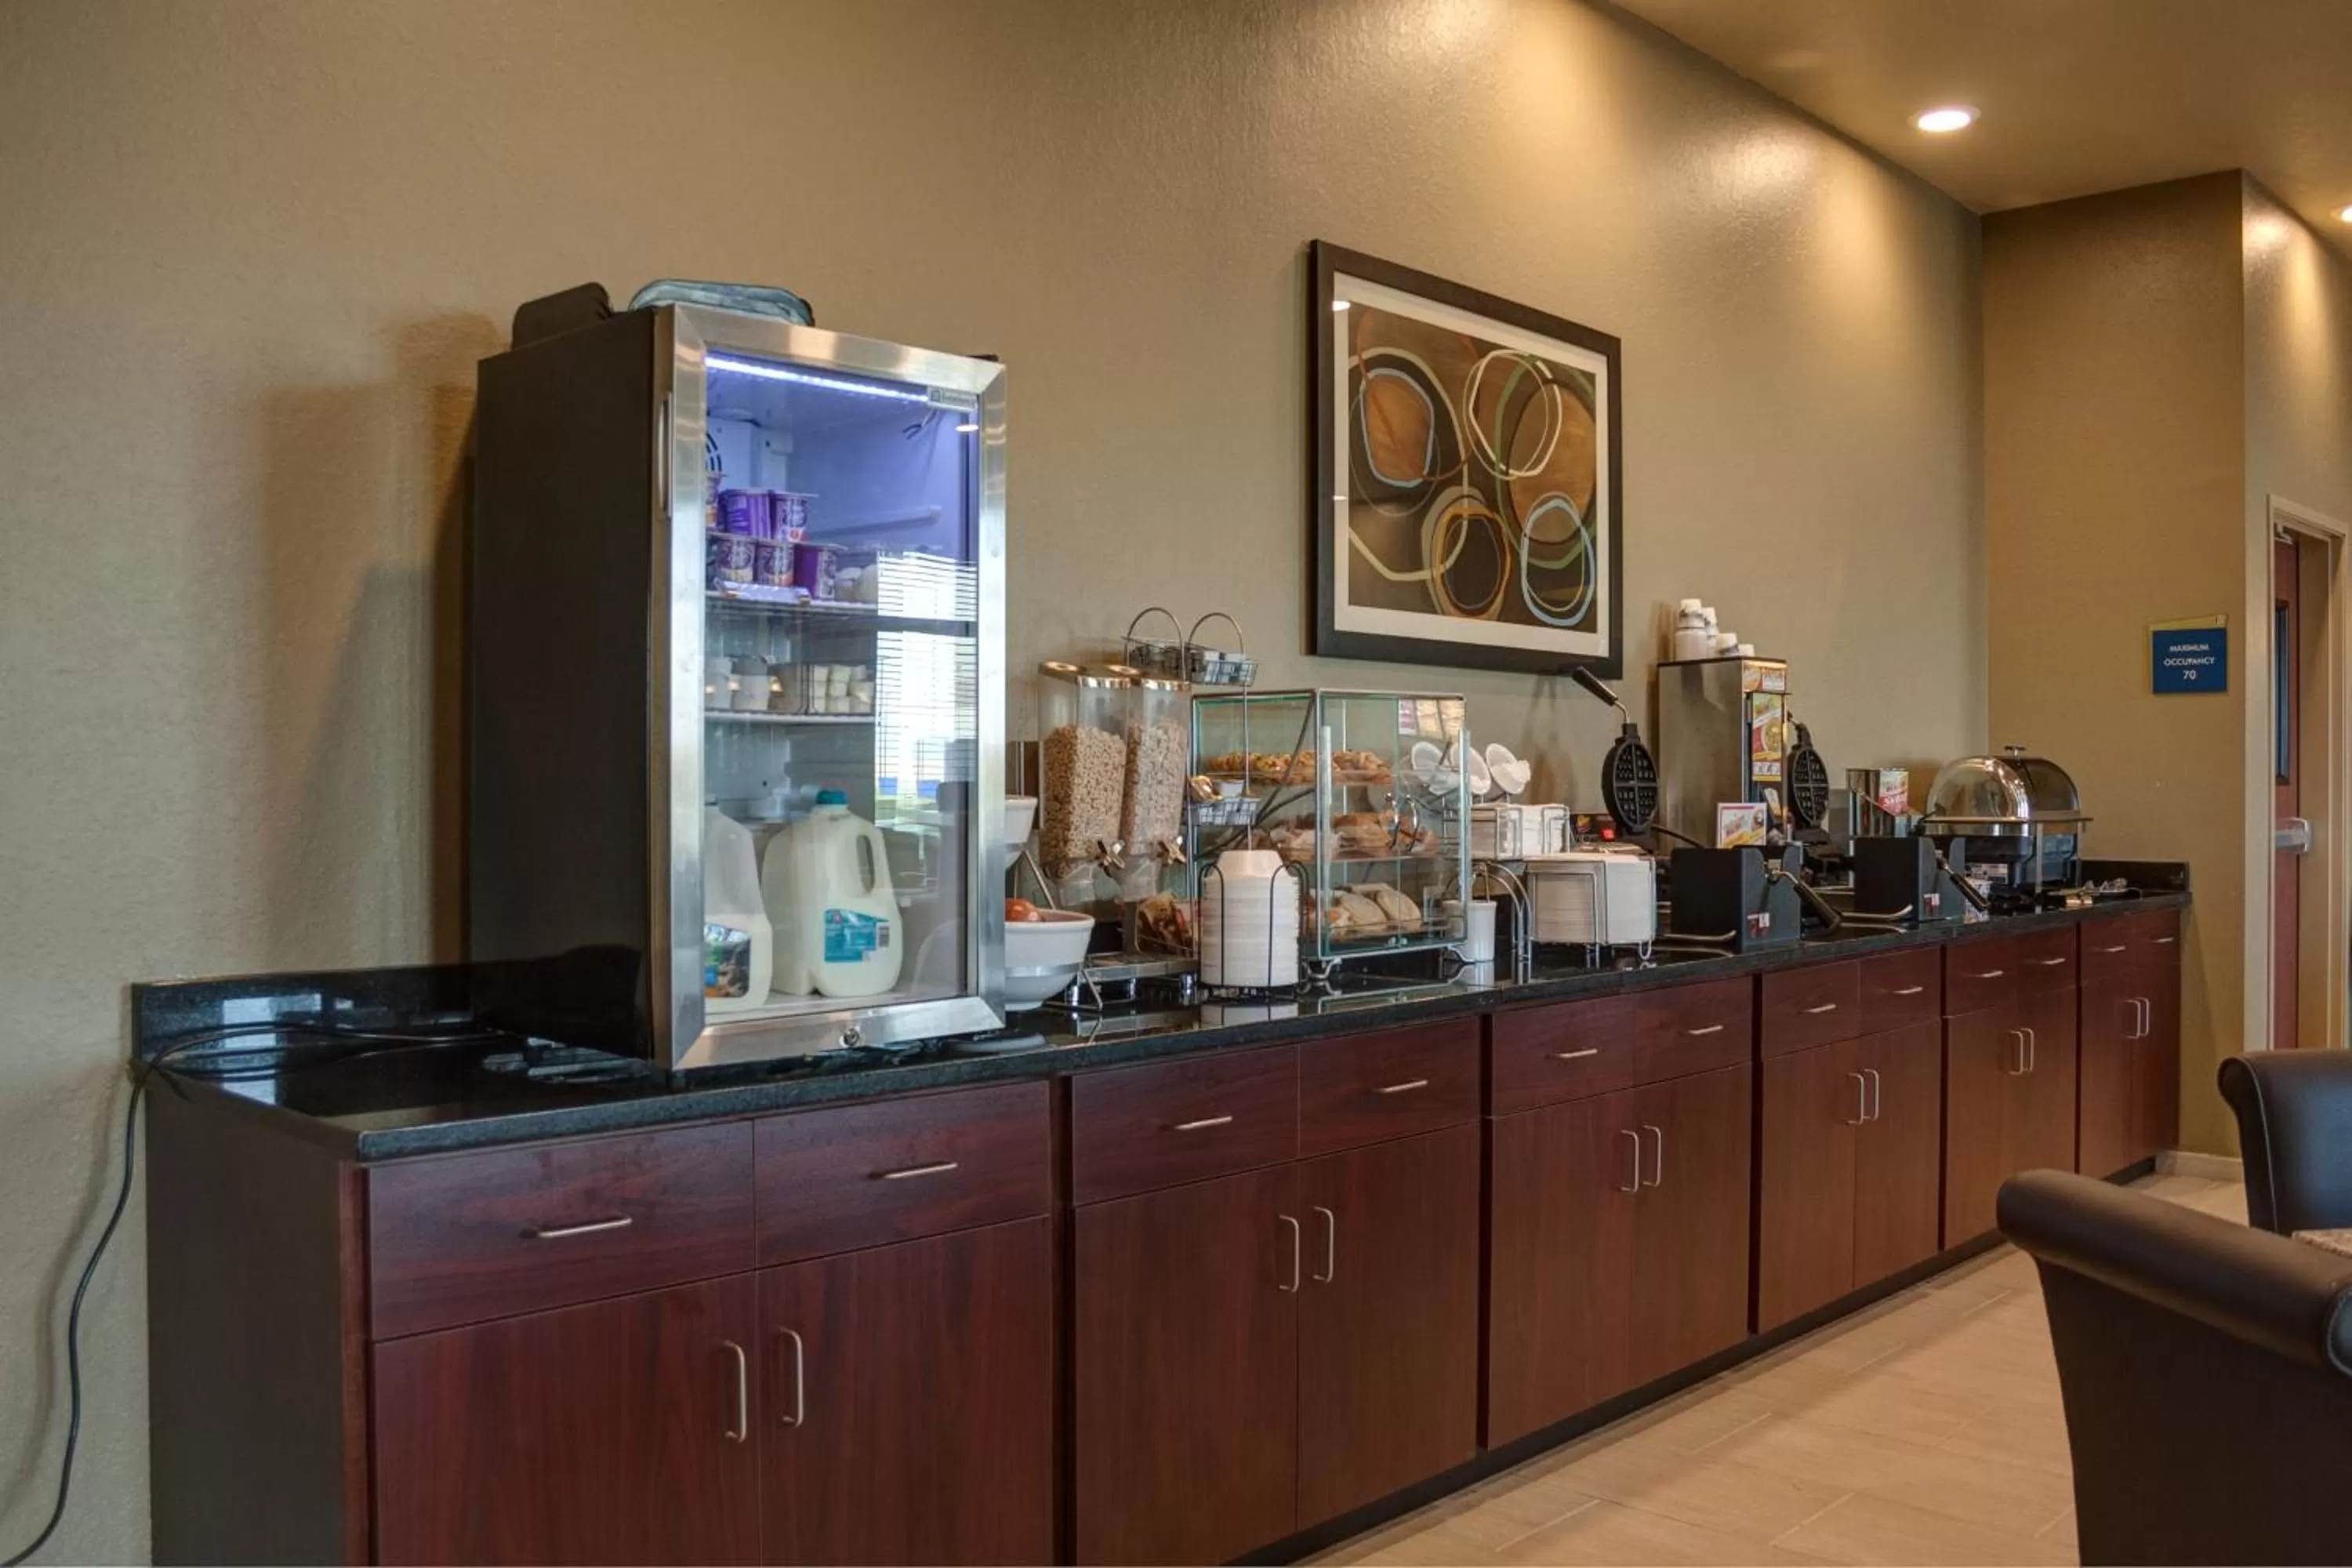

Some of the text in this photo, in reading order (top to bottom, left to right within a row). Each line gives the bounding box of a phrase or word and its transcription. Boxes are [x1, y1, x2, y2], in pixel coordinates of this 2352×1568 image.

[2169, 644, 2209, 652] MAXIMUM
[2163, 656, 2215, 666] OCCUPANCY
[2183, 670, 2197, 680] 70
